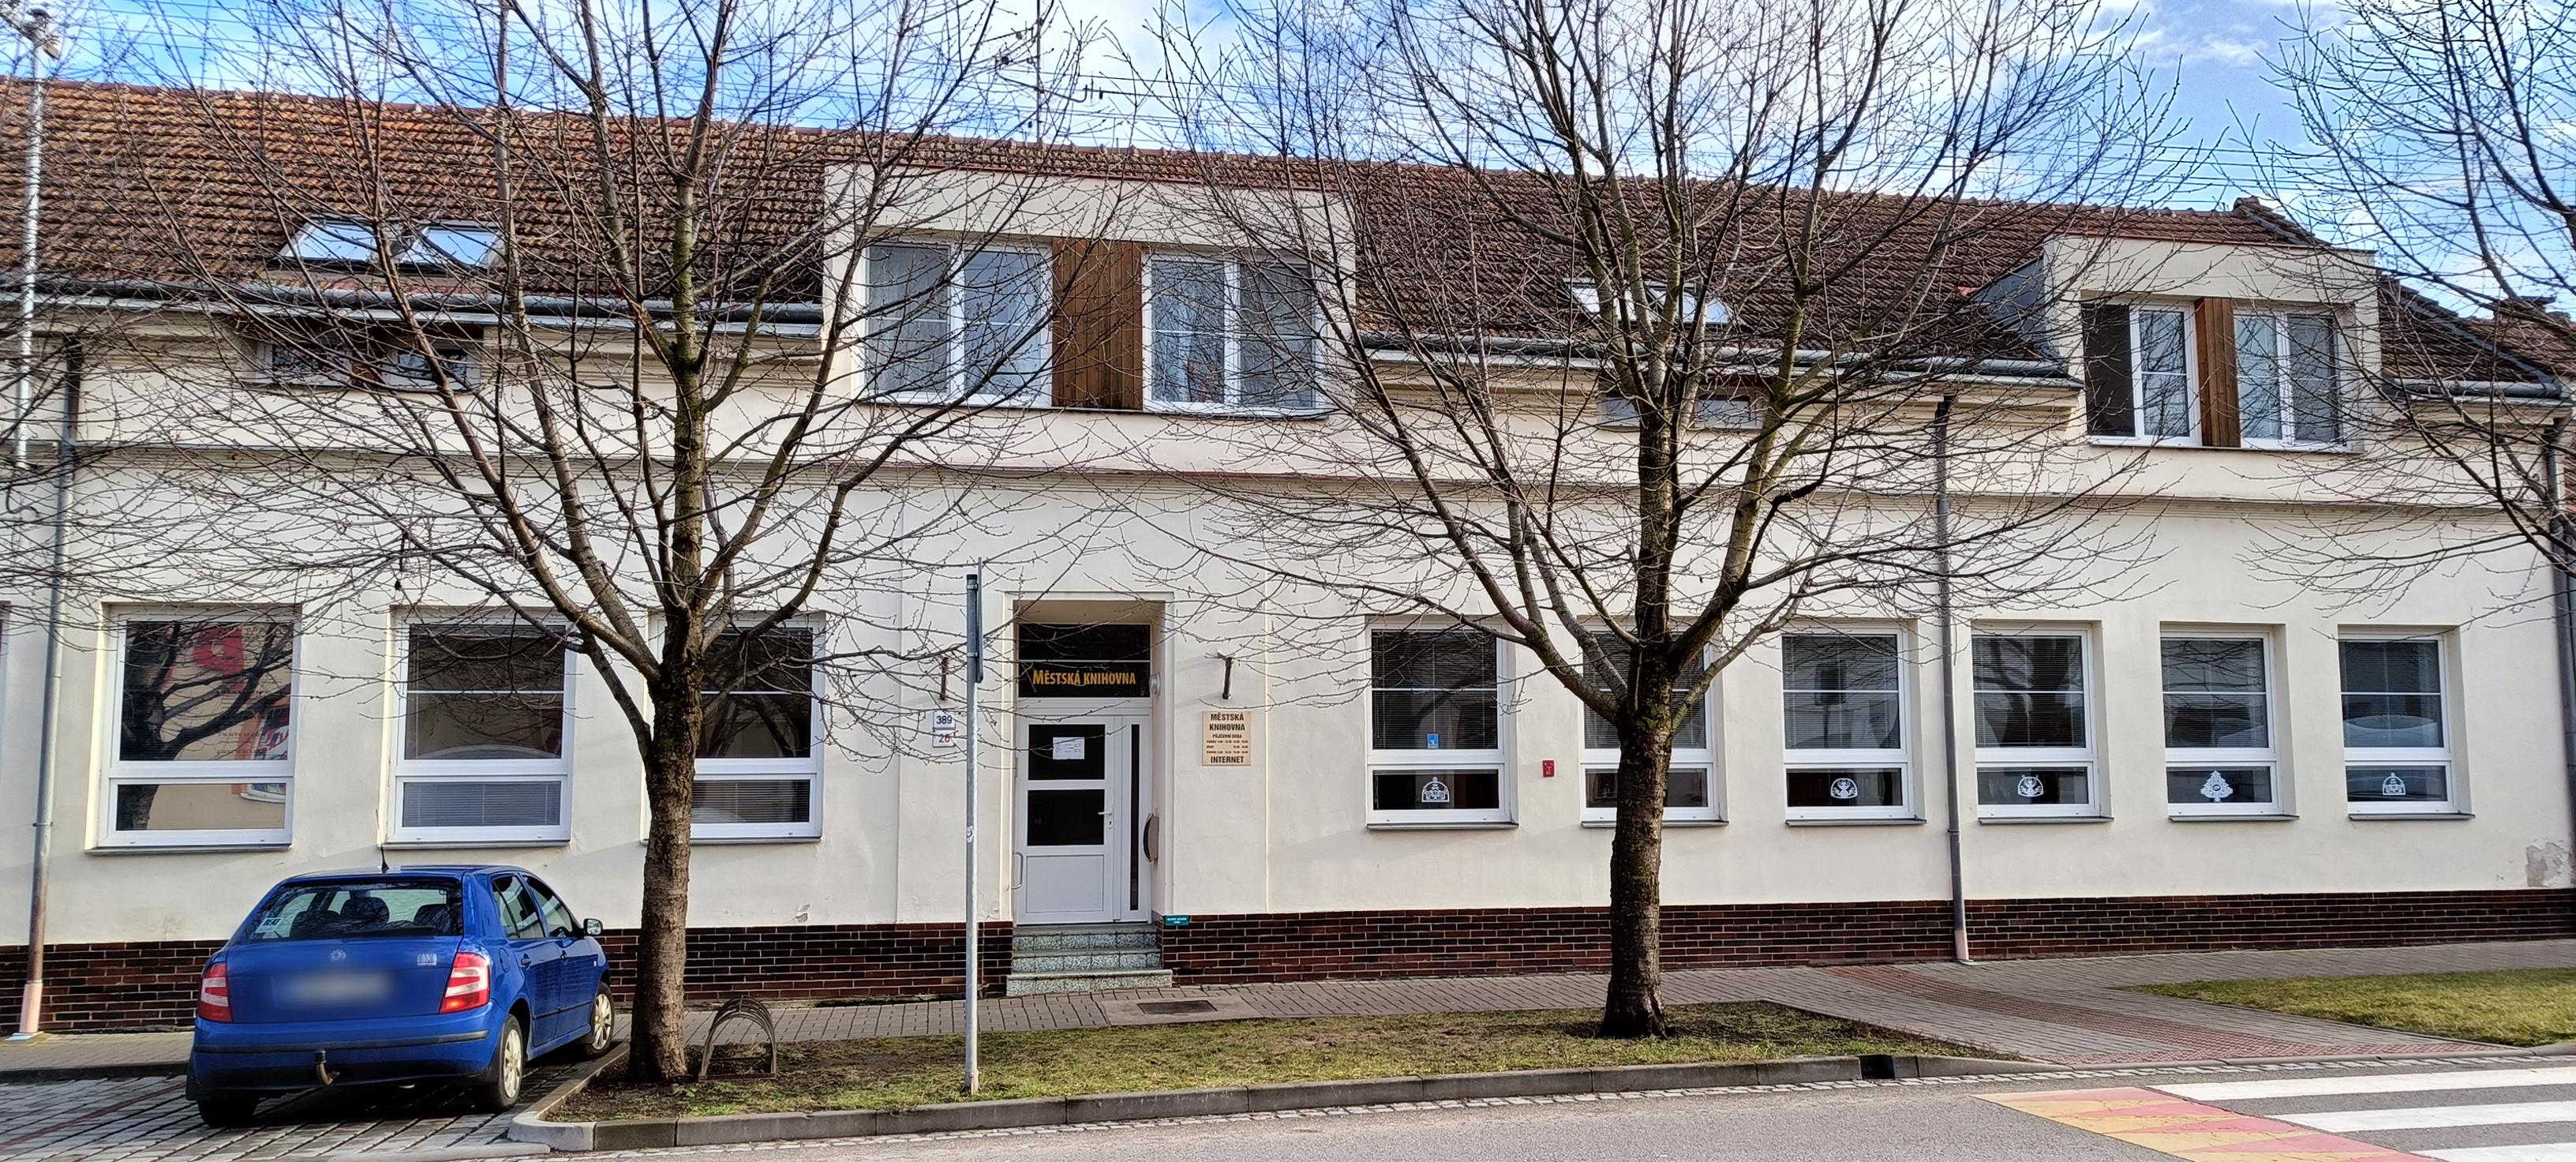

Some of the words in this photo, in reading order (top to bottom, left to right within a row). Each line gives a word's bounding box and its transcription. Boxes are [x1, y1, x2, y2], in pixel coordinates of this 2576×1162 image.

[1032, 669, 1081, 685] MĚSTSKÁ
[1084, 672, 1136, 685] KNIHOVNA
[936, 715, 953, 725] 389
[1210, 712, 1245, 722] MĚSTSKÁ
[1210, 755, 1245, 764] INTERNET
